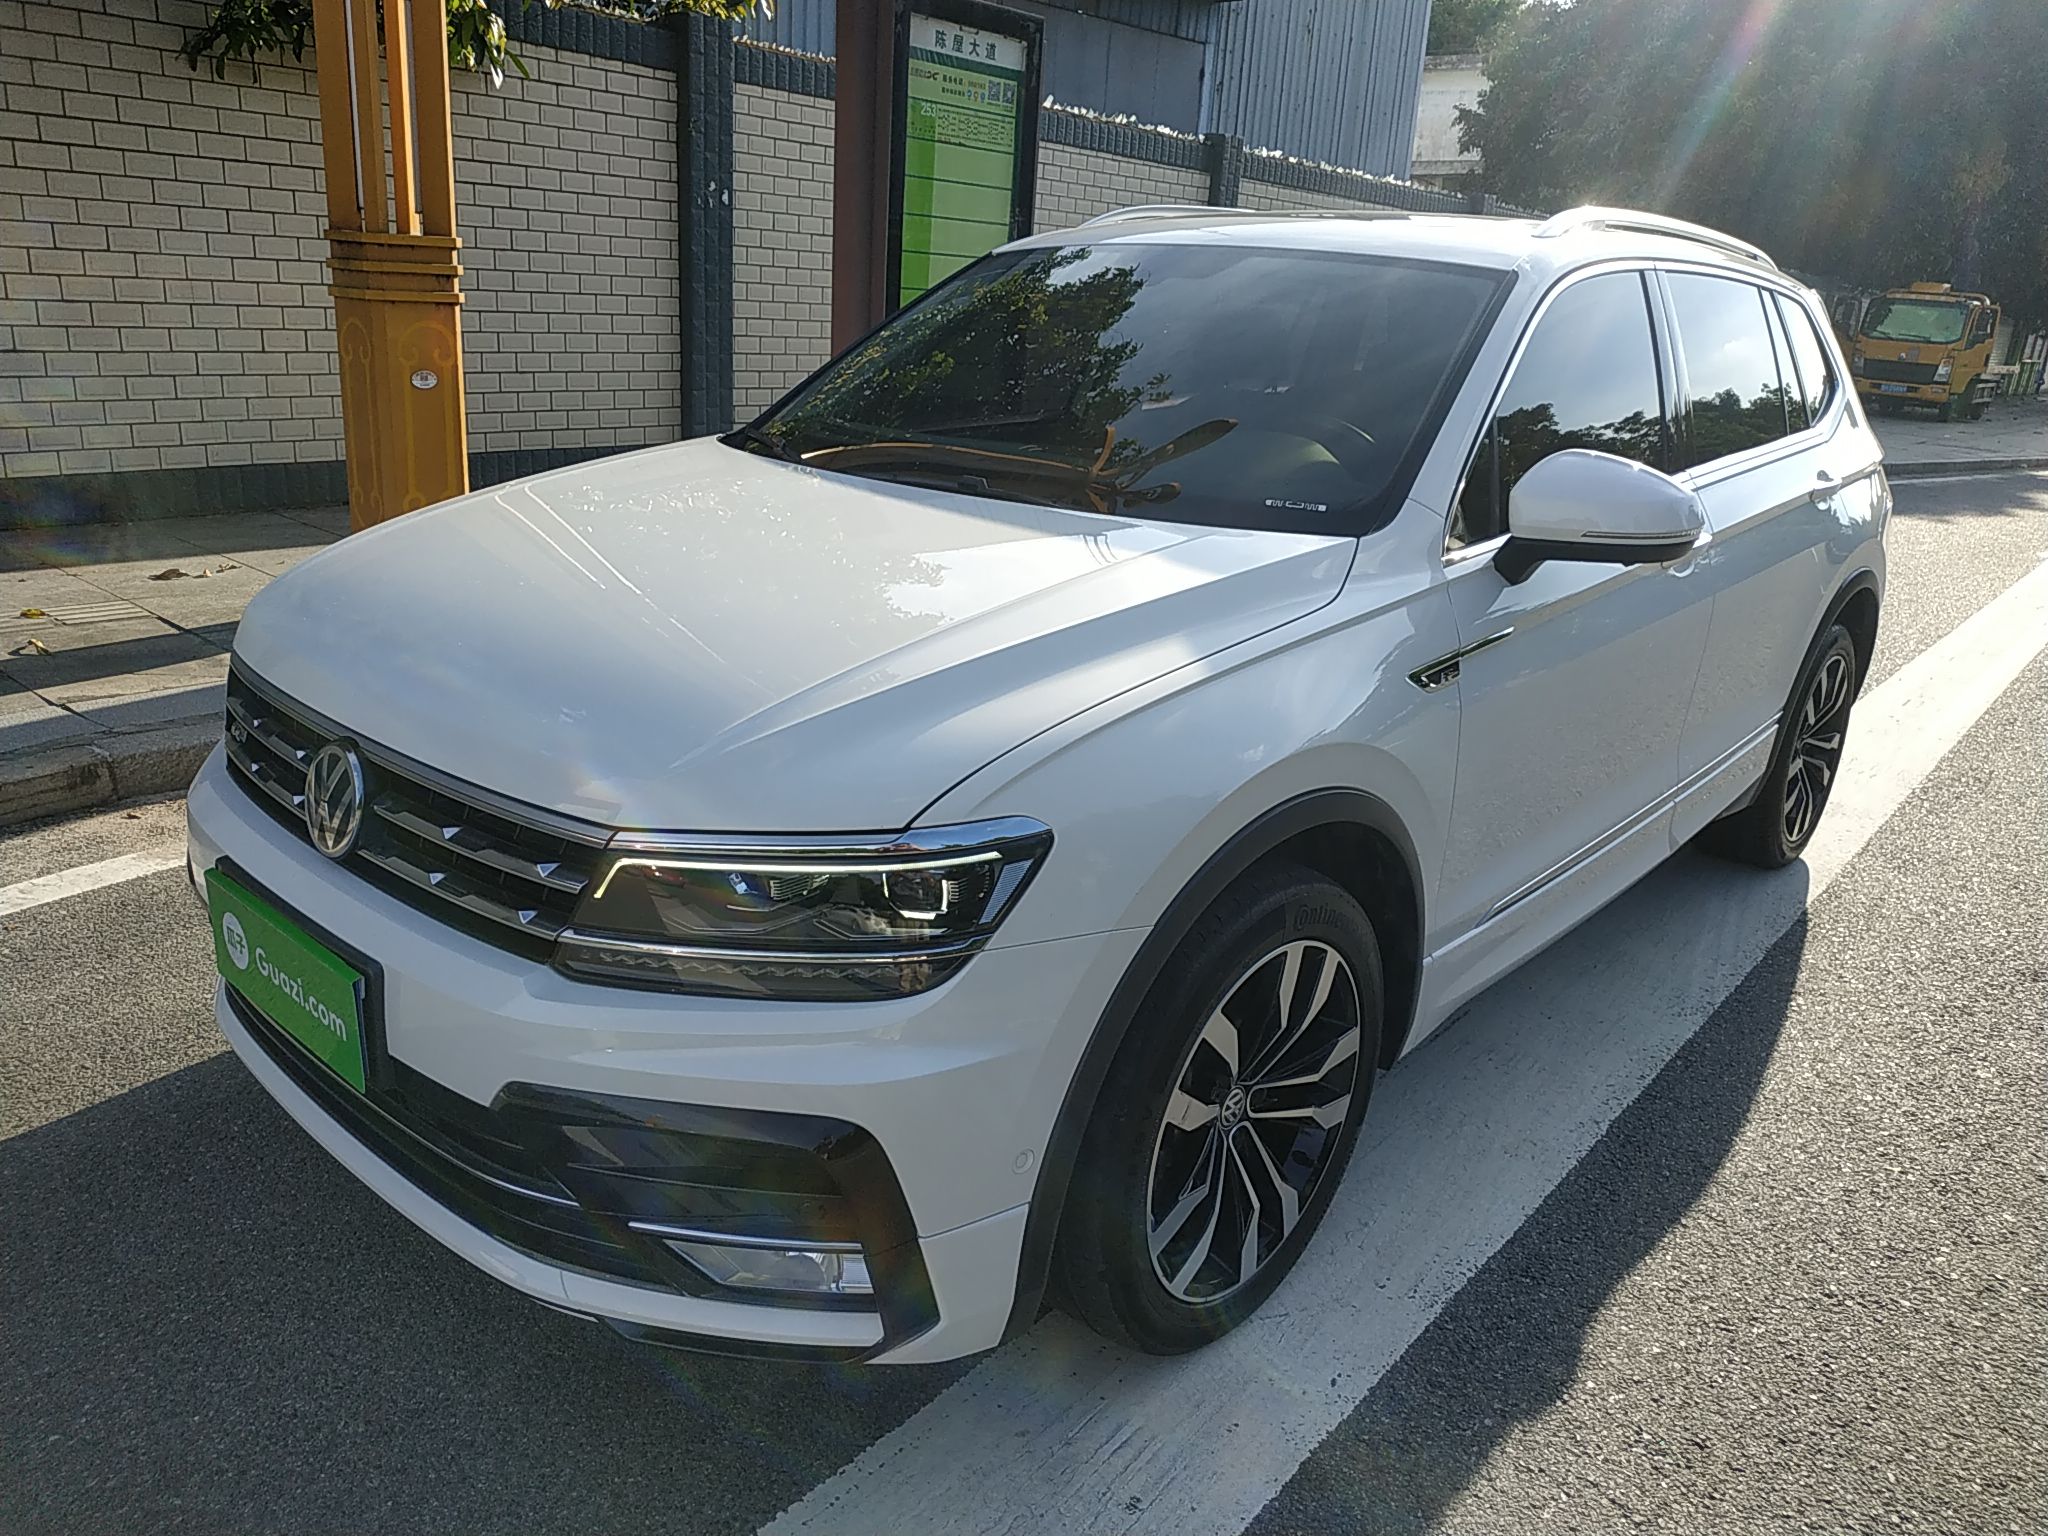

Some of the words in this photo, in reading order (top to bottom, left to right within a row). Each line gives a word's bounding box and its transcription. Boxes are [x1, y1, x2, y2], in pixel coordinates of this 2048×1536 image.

[935, 29, 996, 61] 陈屋大道
[921, 102, 938, 117] 253
[226, 925, 246, 956] 瓜子
[255, 946, 347, 1042] Guazi.com
